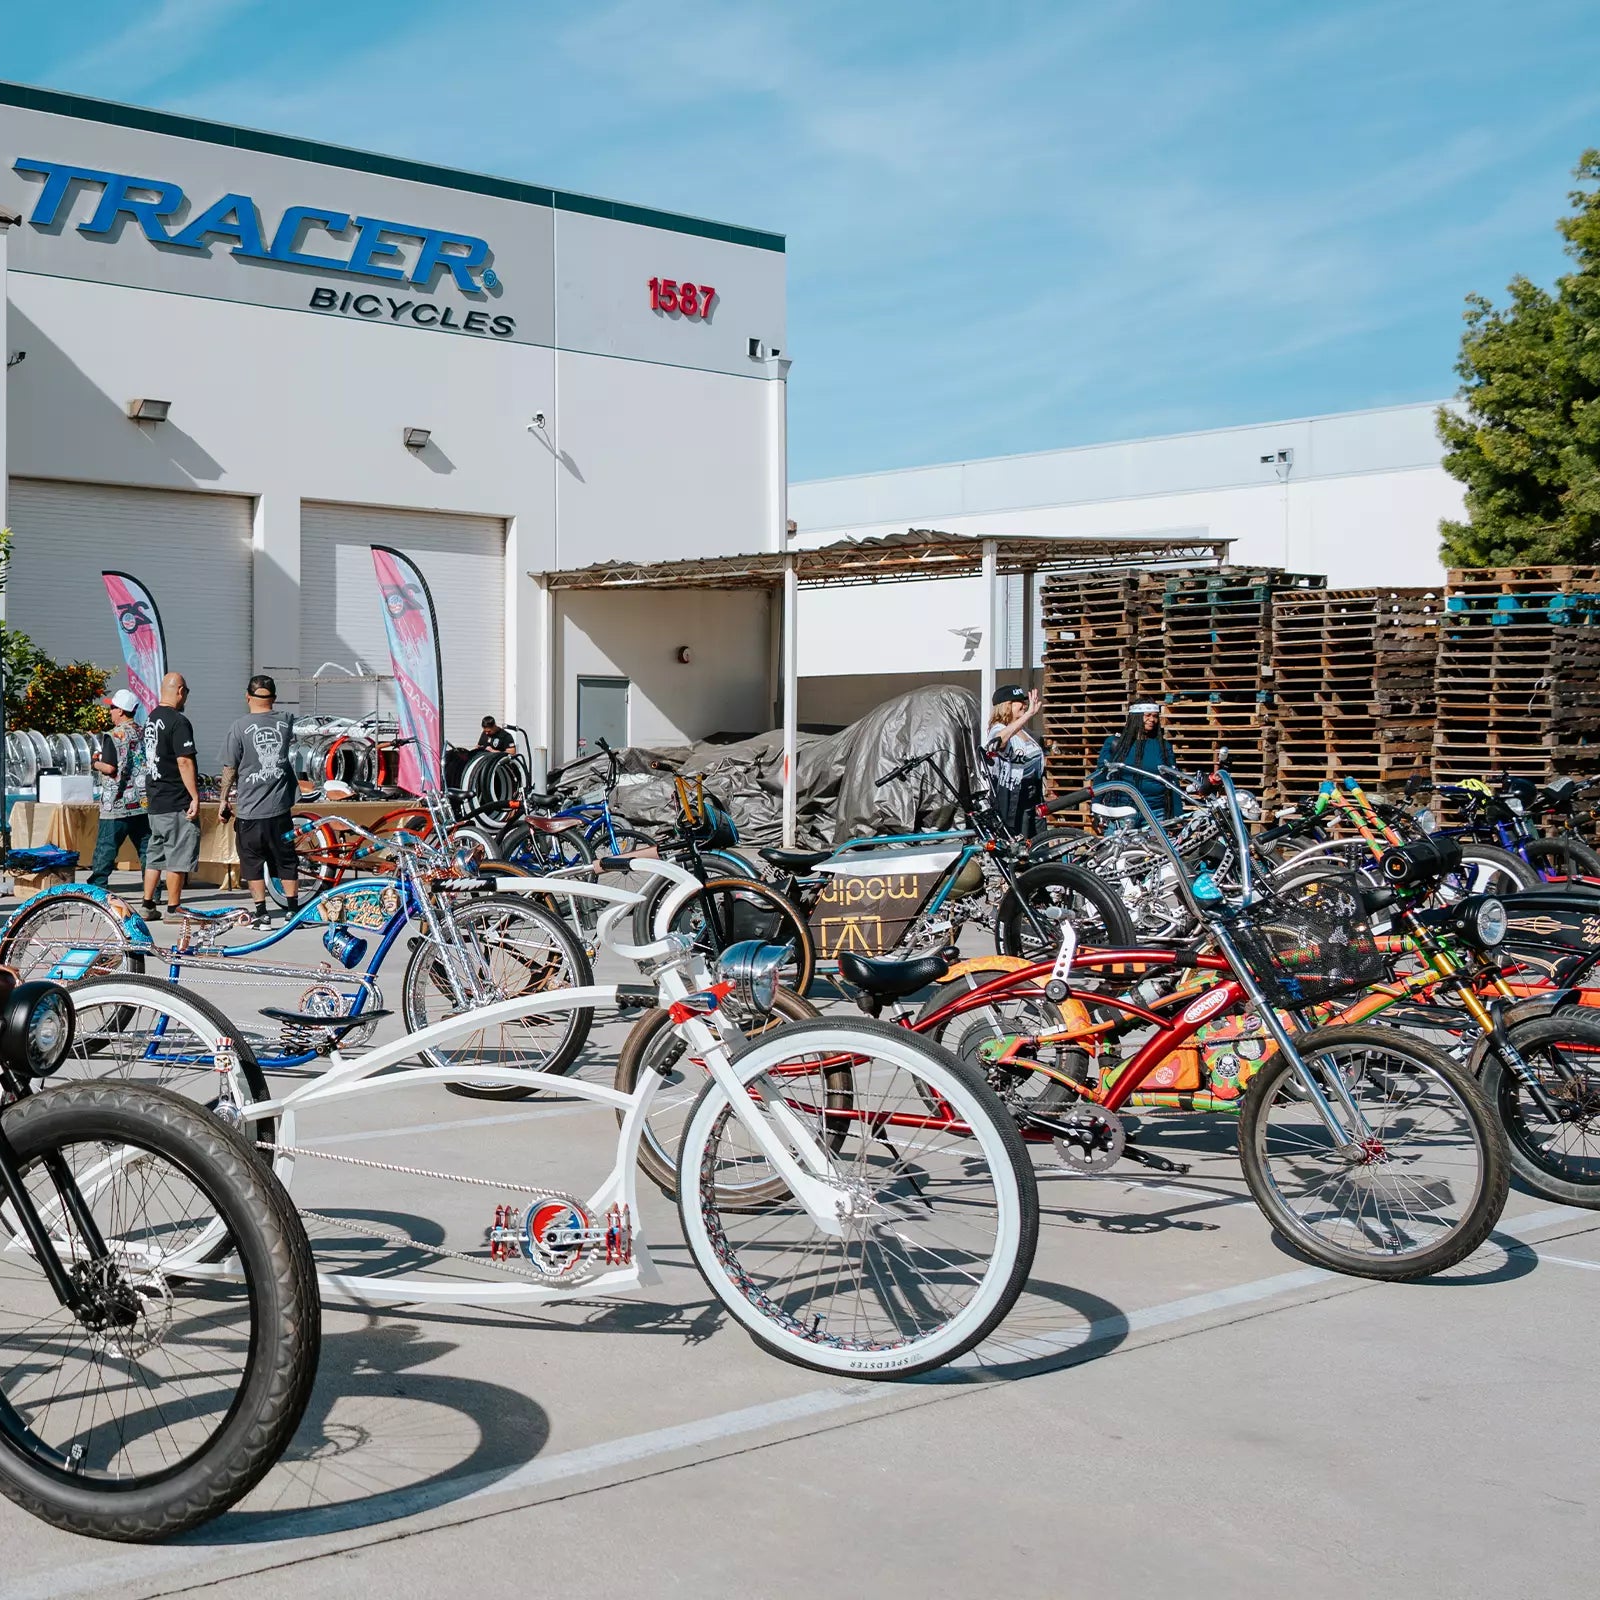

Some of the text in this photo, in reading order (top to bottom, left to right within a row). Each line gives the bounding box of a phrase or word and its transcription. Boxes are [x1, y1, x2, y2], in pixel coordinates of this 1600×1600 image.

[309, 287, 516, 336] BICYCLES
[647, 276, 716, 319] 1587
[850, 1357, 908, 1369] SPEEDSTER
